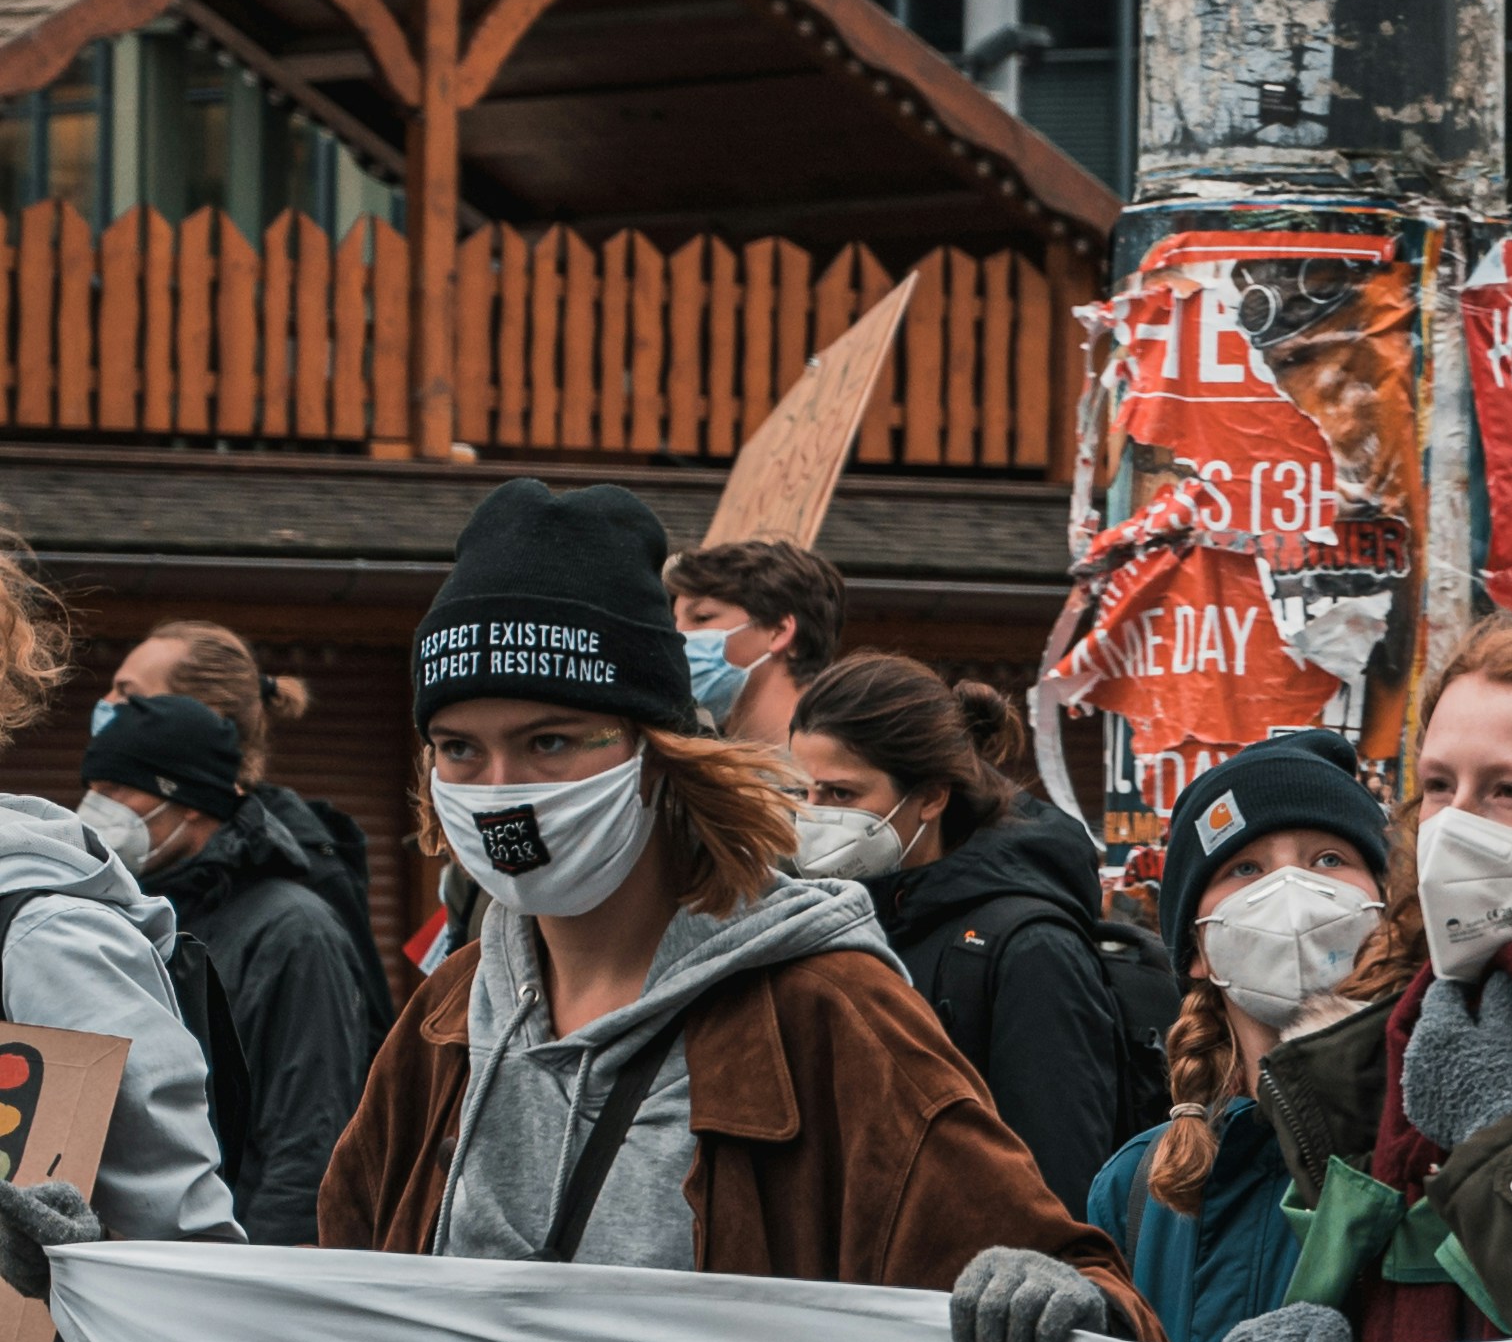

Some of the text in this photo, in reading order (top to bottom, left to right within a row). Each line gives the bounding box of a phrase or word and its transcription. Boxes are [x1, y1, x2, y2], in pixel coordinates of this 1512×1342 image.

[489, 621, 600, 653] EXISTENCE
[1171, 604, 1259, 677] DAY
[424, 650, 618, 687] EXPECT RESISTANCE
